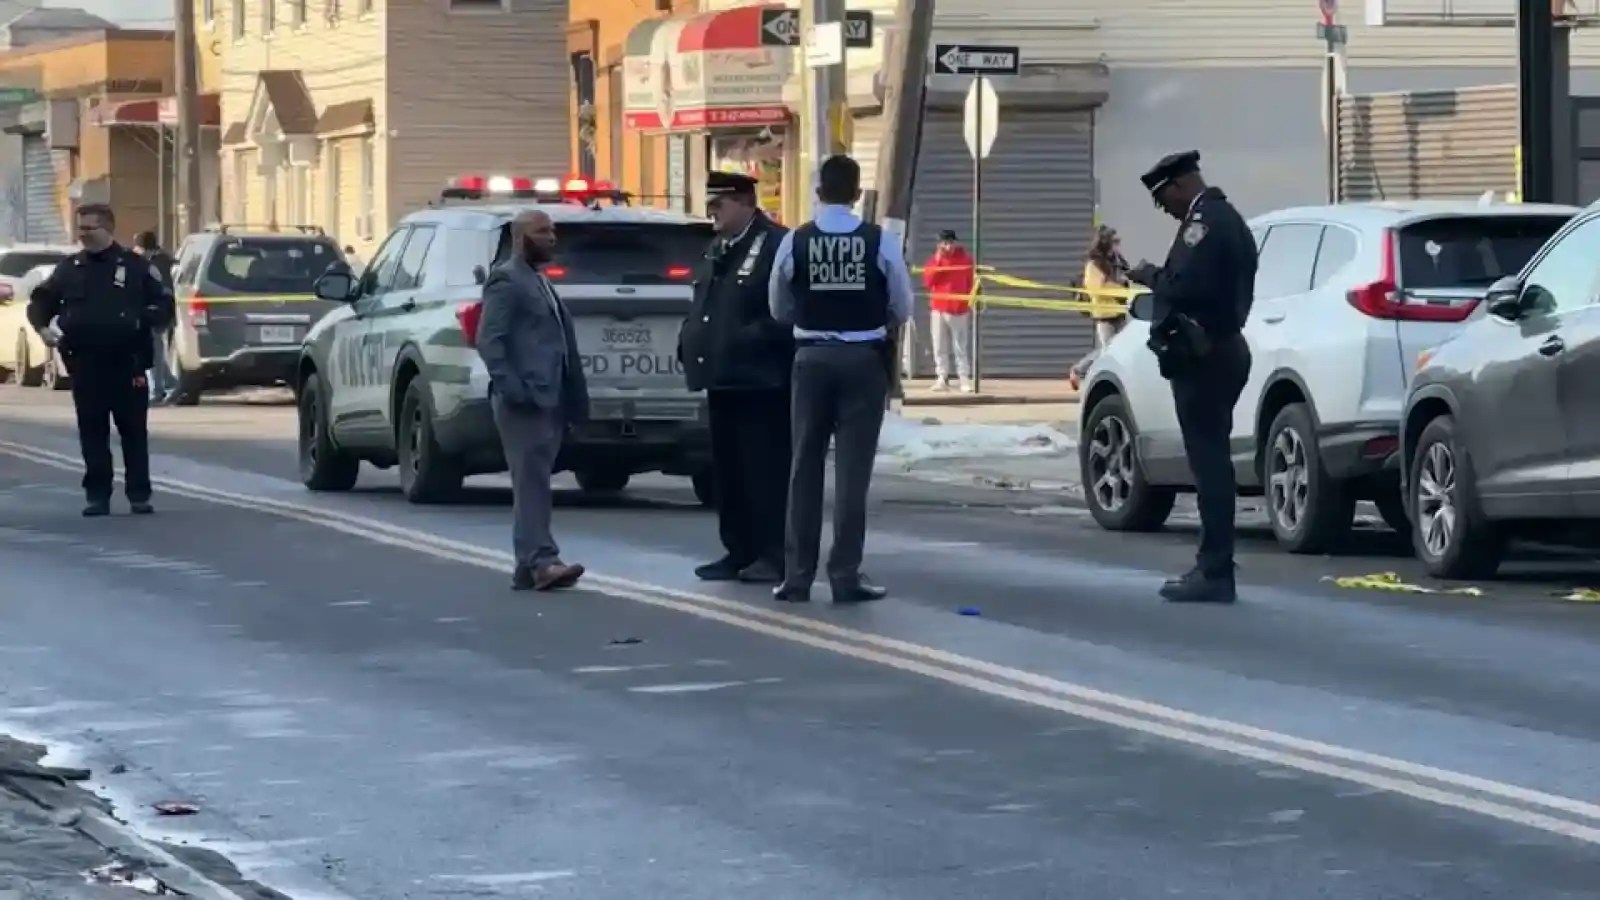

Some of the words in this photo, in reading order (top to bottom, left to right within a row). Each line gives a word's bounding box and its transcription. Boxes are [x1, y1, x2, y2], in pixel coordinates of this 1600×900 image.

[948, 53, 972, 65] ONE
[982, 54, 1008, 67] WAY
[809, 236, 866, 262] NYPD
[809, 262, 866, 283] POLICE
[620, 354, 685, 375] POLIC
